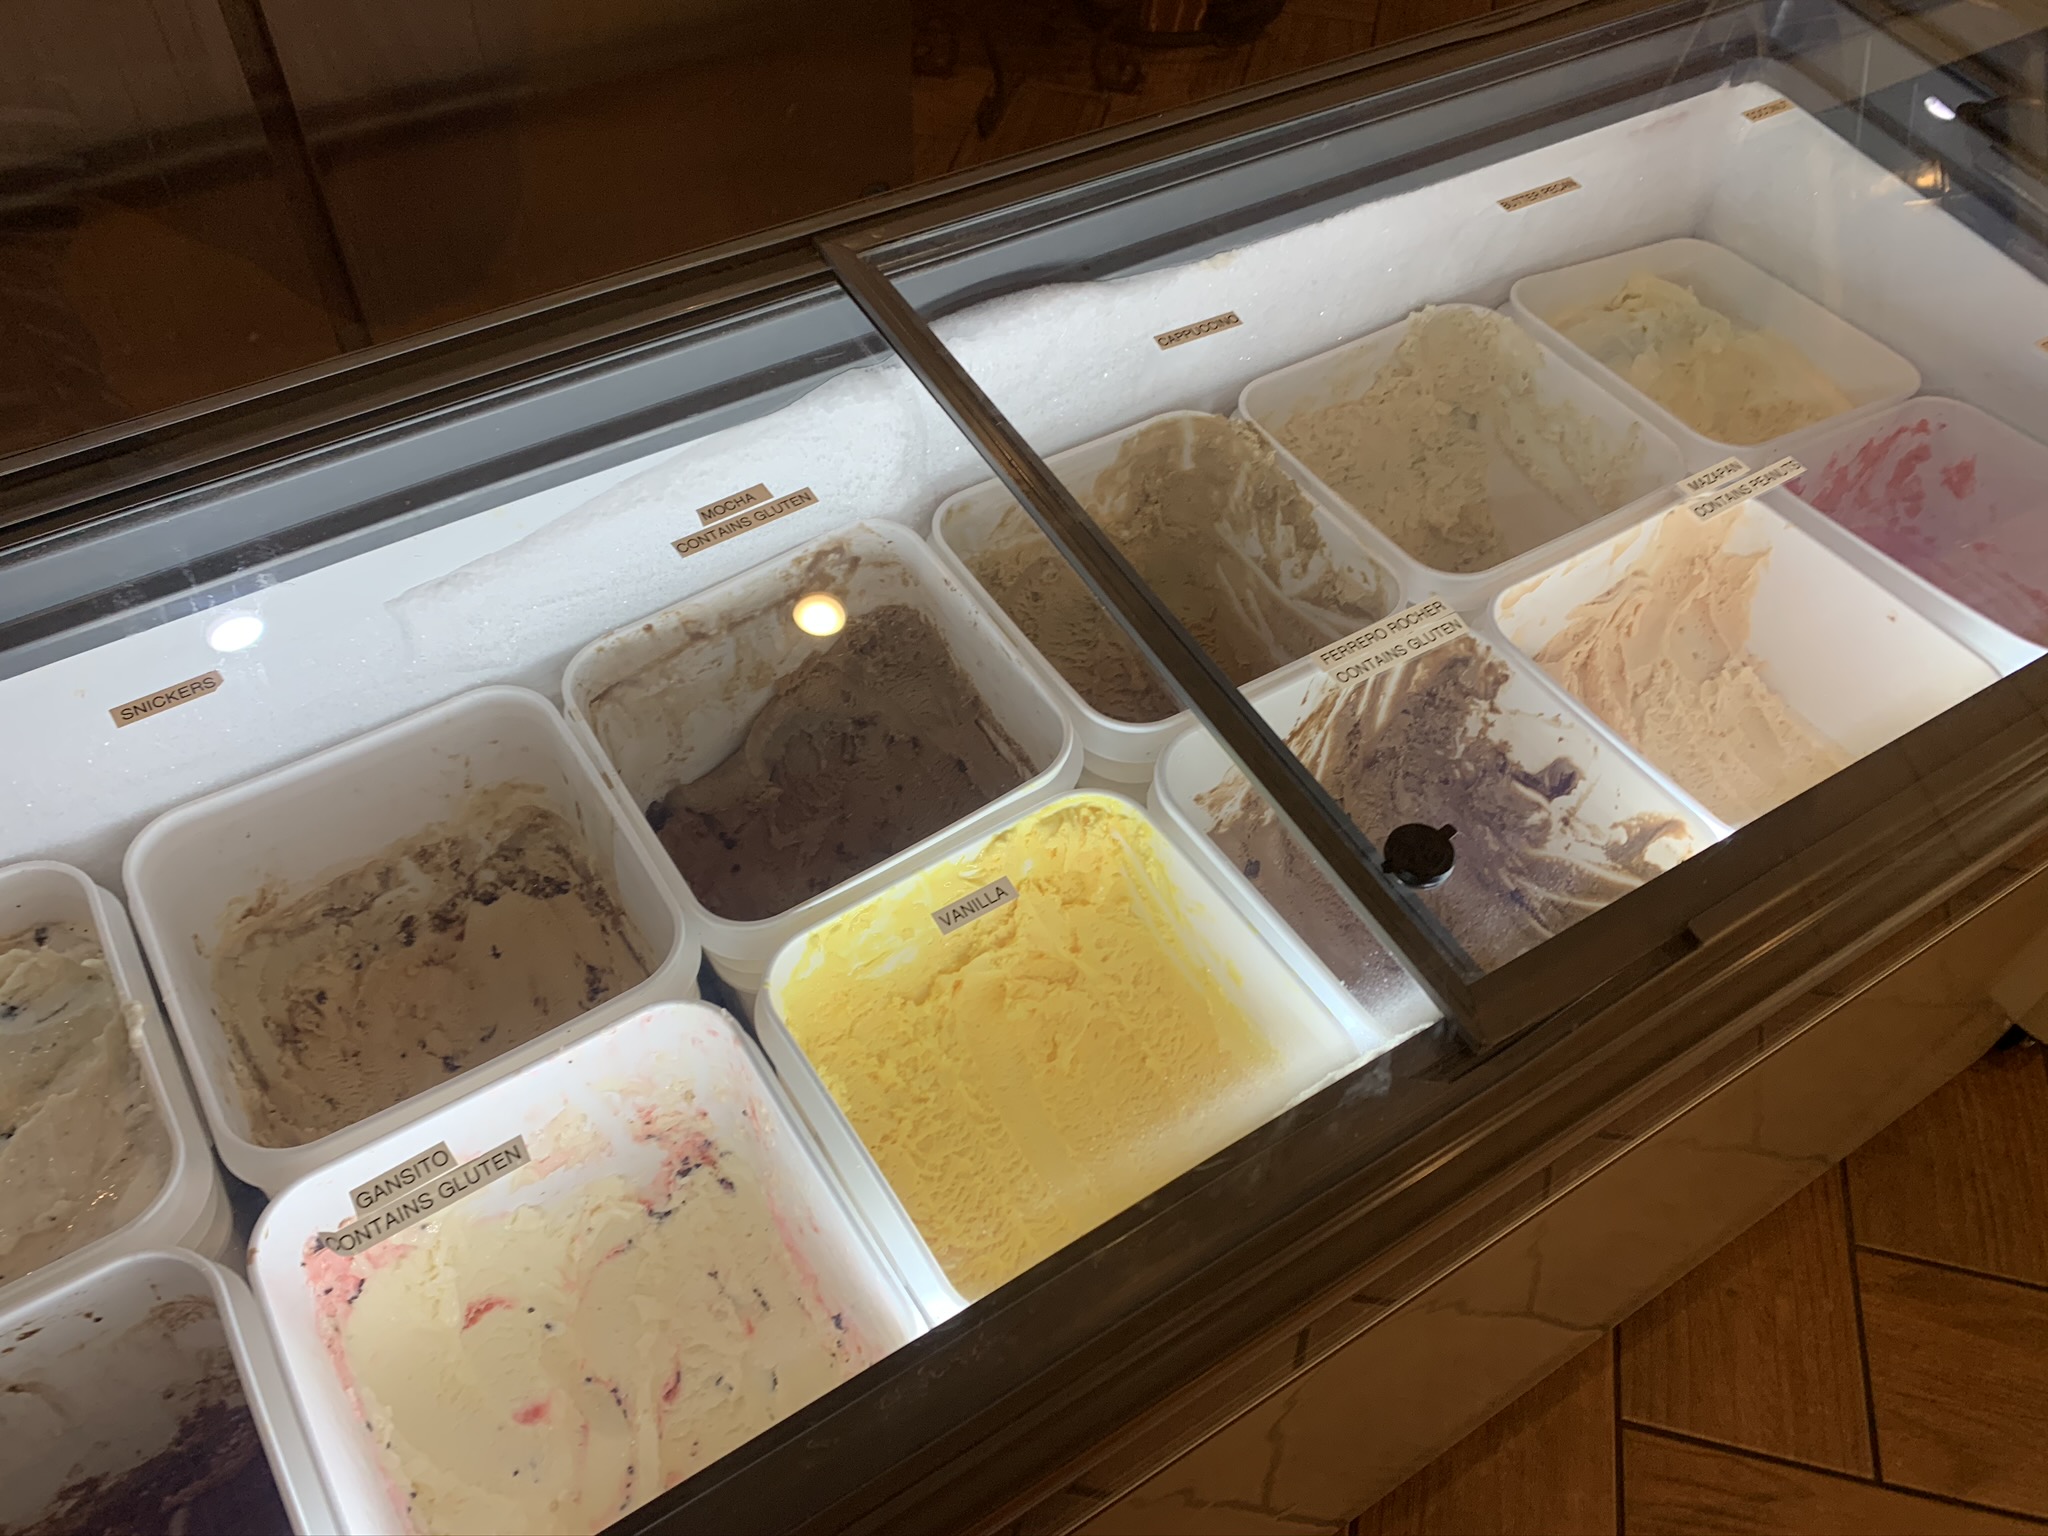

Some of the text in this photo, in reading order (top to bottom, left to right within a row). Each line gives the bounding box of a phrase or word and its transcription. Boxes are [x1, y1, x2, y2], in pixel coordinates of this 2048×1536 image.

[1157, 314, 1240, 347] CAPPUCCINO
[676, 492, 812, 554] CONTAINS GLUTEN
[700, 493, 757, 521] MOCHA
[1693, 482, 1753, 517] CONTAINS
[1320, 600, 1447, 666] FERRERO ROCHER
[1336, 618, 1463, 683] CONTAINS GLUTEN
[120, 677, 216, 720] SNICKERS
[938, 886, 1009, 926] VANILLA
[325, 1145, 522, 1251] CONTAINS GLUTEN
[356, 1150, 449, 1209] GANSITO
